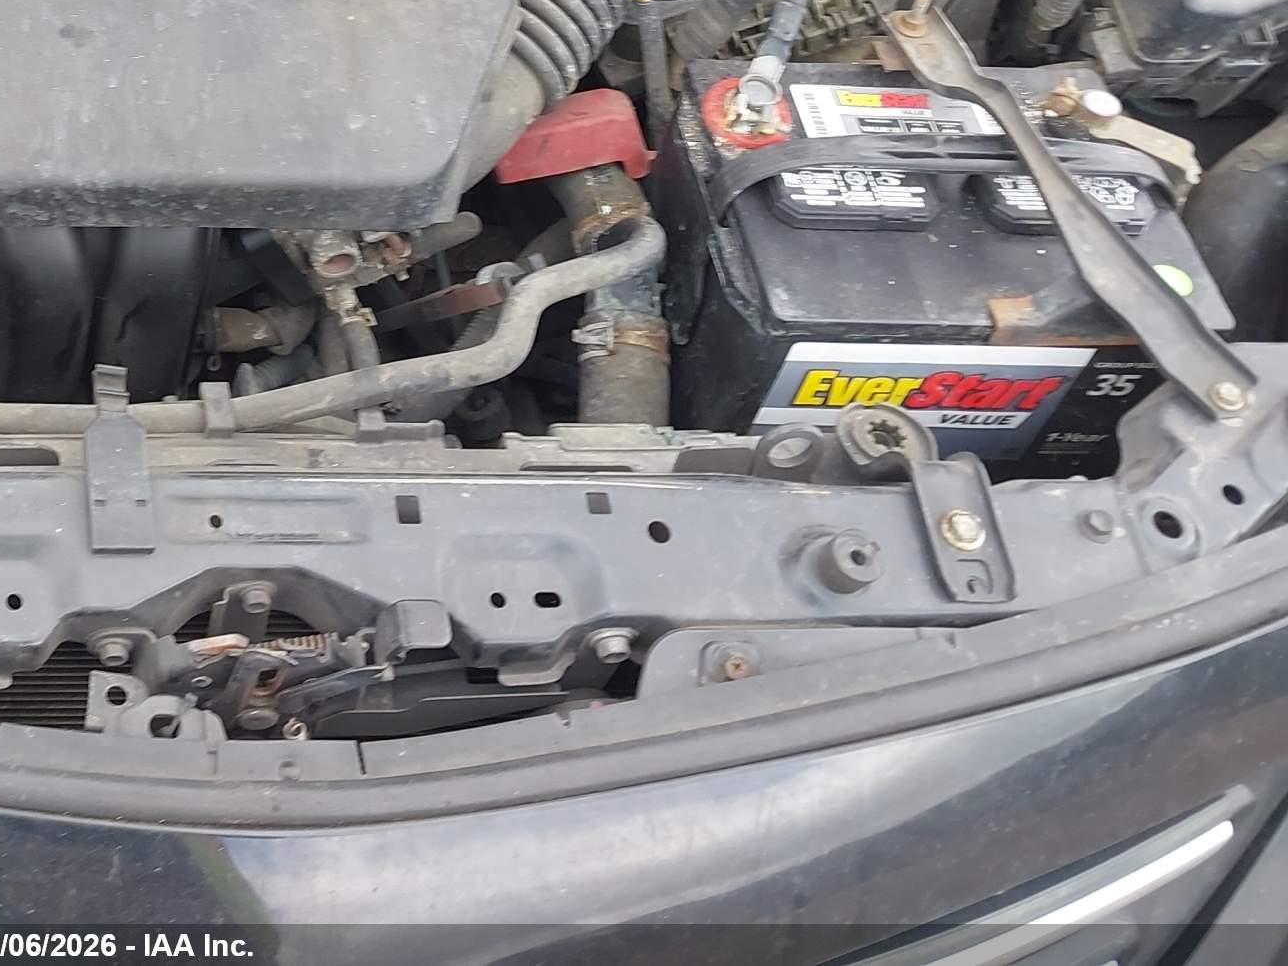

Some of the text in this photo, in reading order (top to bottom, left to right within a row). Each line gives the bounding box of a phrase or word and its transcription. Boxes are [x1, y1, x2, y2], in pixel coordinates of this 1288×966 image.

[791, 369, 1065, 411] EverStart
[1085, 373, 1144, 397] 35
[940, 413, 1016, 426] VALUE
[1045, 432, 1110, 443] 1-Year
